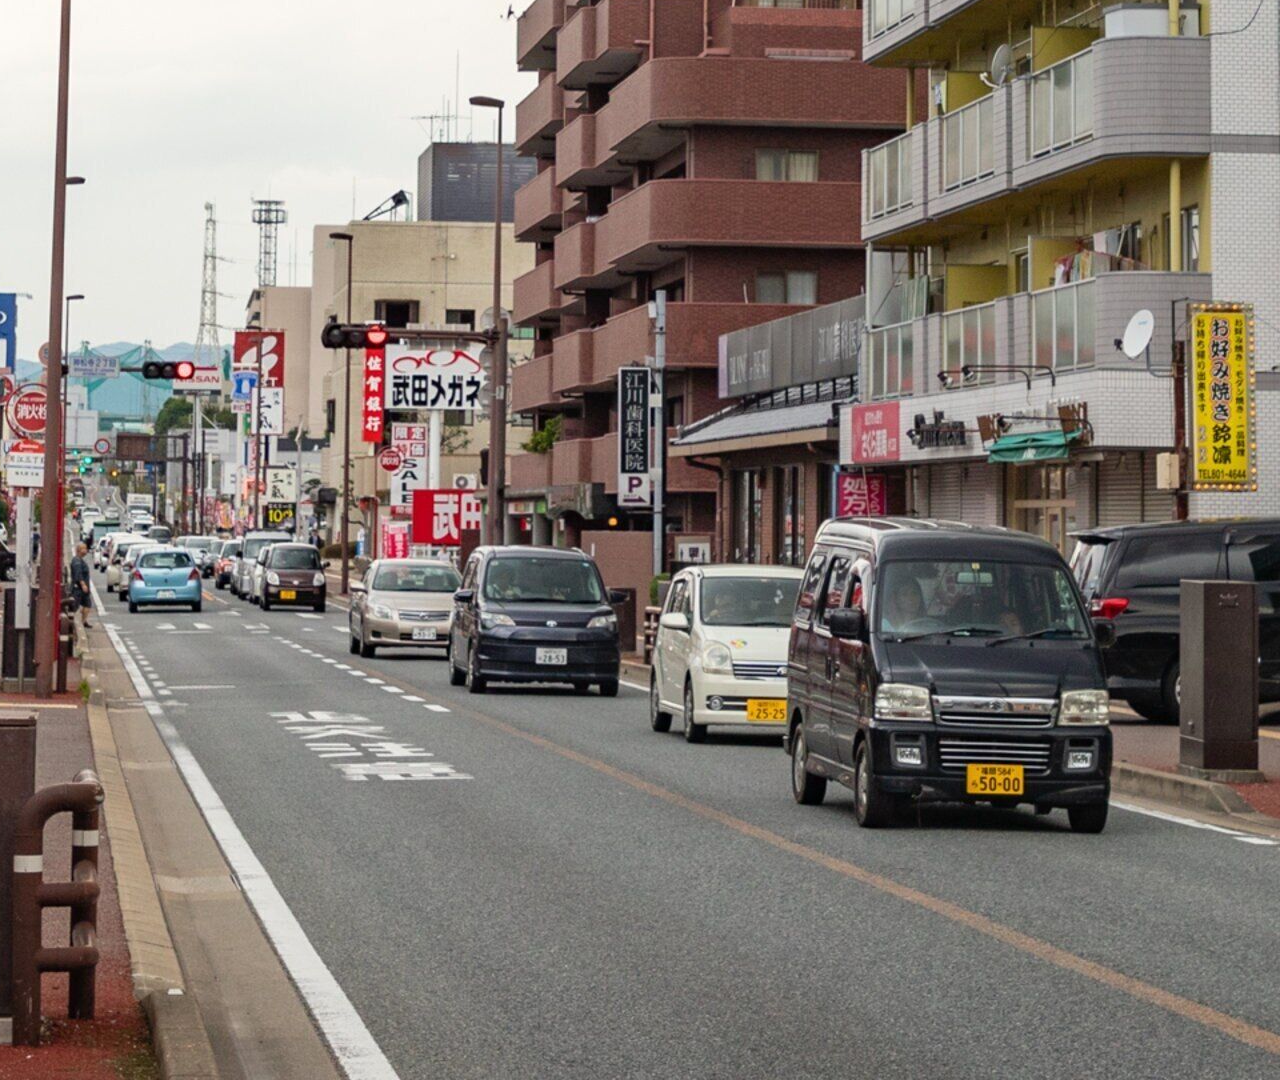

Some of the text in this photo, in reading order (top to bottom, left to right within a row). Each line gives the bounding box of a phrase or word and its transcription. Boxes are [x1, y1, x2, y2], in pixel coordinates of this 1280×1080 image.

[365, 356, 382, 433] 佐賀銀行
[392, 375, 481, 407] 武田メガネ
[625, 372, 644, 471] 江川歯科医院
[401, 458, 419, 504] SALE
[628, 476, 643, 493] P
[843, 476, 869, 516] 処方
[433, 492, 480, 540] 武田
[755, 708, 786, 720] 25-25
[979, 776, 1021, 792] 50-00
